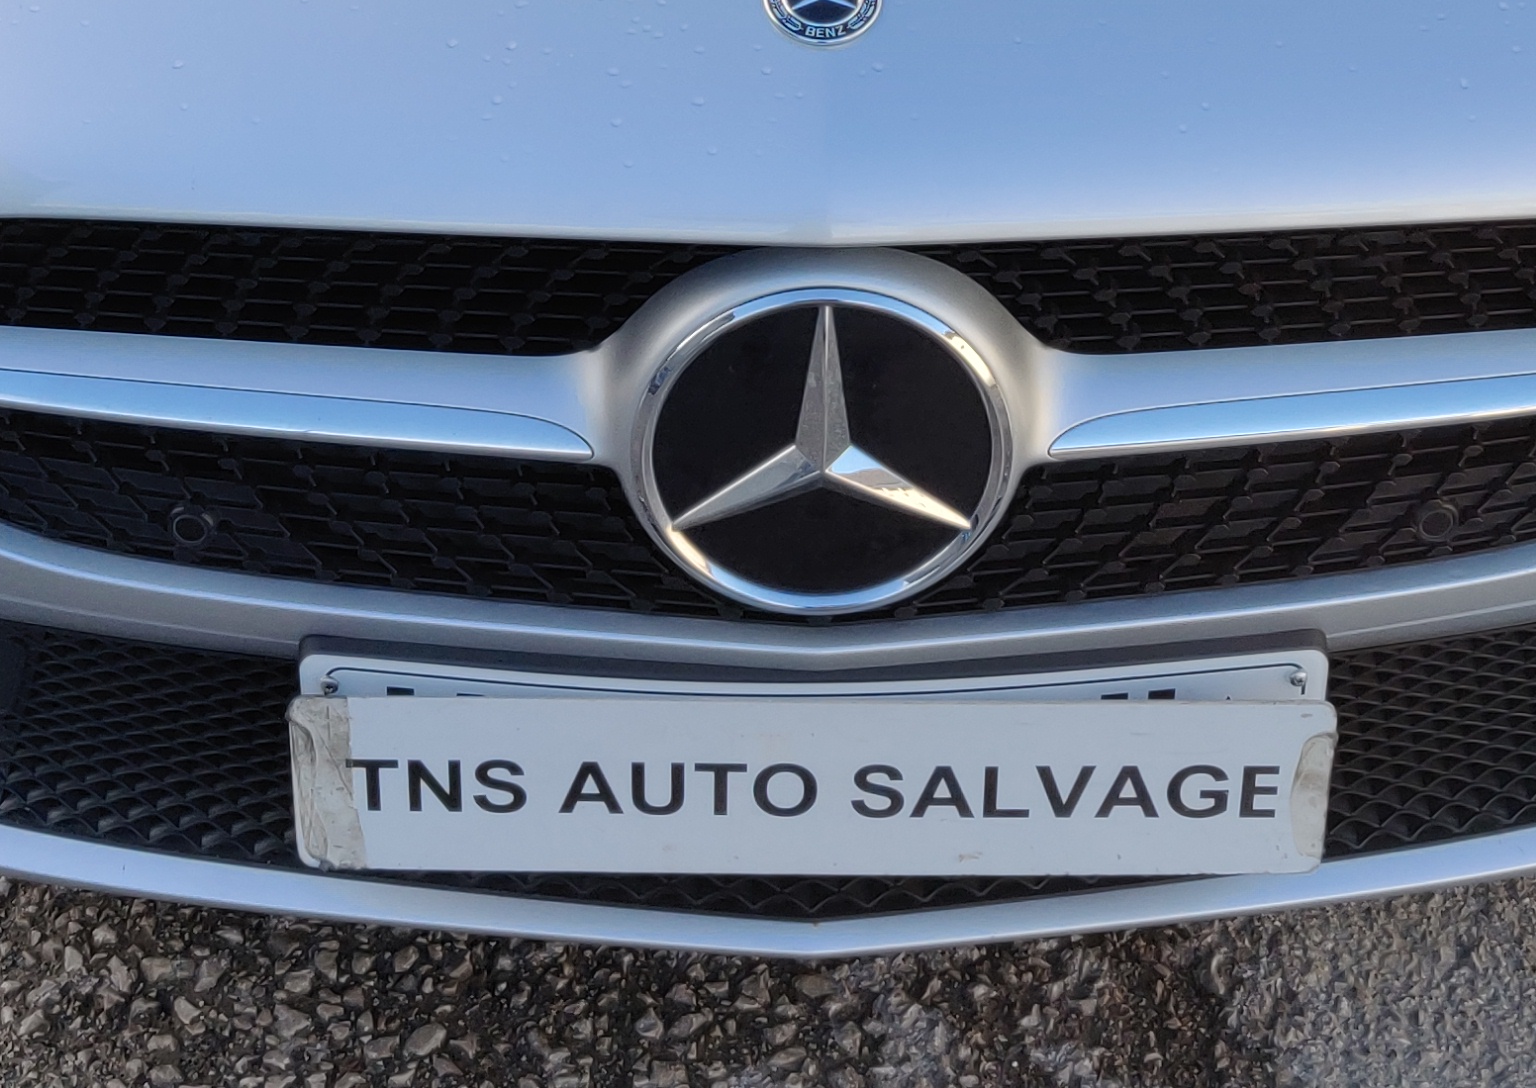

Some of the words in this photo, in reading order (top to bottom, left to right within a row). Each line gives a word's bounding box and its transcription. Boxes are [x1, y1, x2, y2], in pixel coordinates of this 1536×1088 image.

[805, 25, 847, 38] BENZ
[344, 758, 527, 814] TNS
[558, 761, 818, 817] AUTO
[850, 764, 1281, 818] SALVAGE
